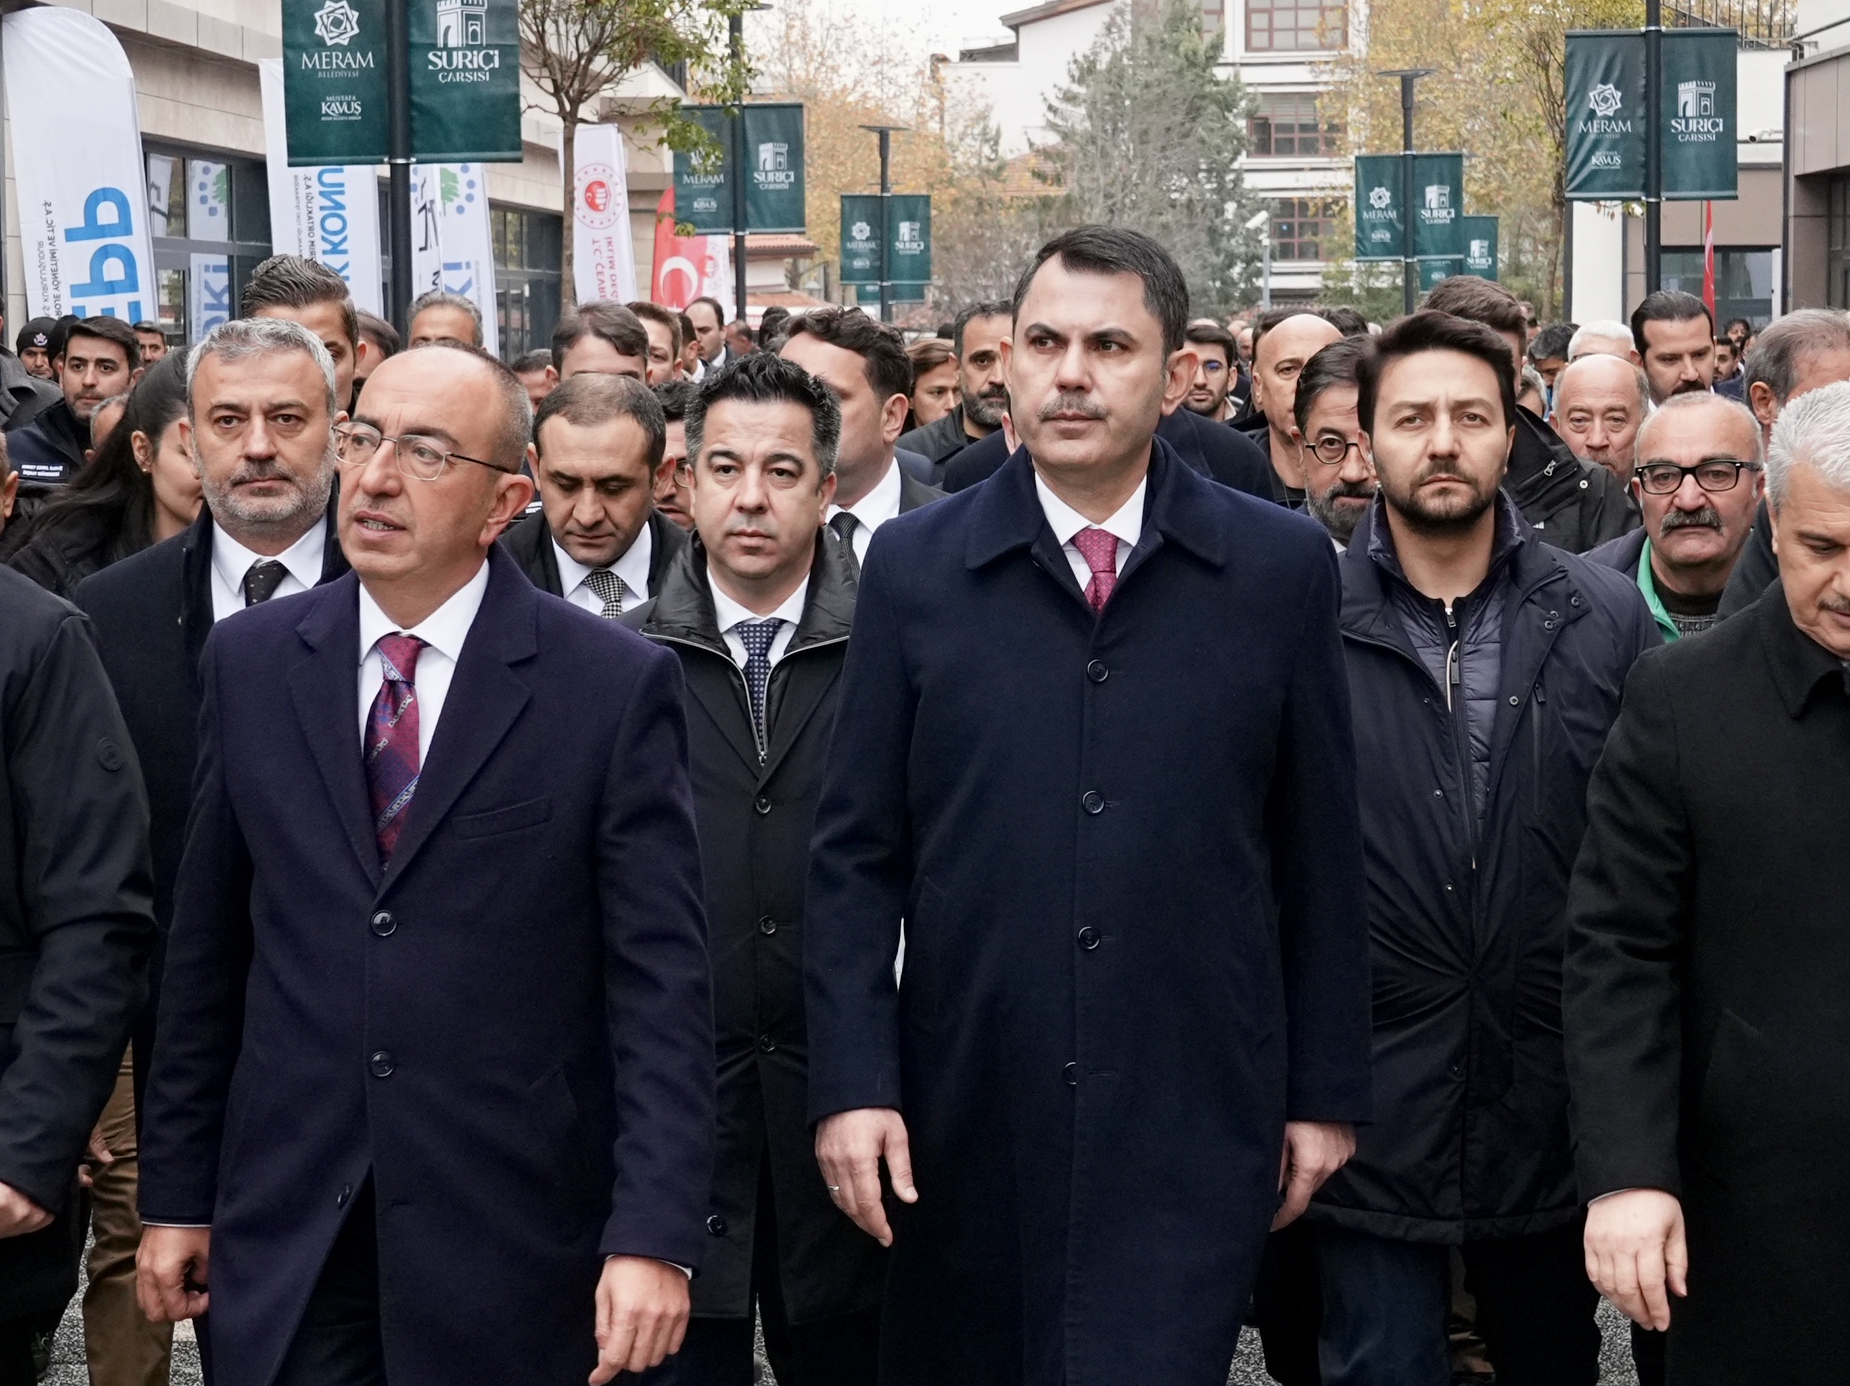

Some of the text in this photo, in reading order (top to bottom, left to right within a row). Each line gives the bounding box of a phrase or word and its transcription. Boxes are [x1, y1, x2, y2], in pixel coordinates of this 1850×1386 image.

[301, 51, 375, 69] MERAM
[428, 50, 499, 71] SURİÇİ
[321, 101, 362, 117] KAVUŞ
[1579, 119, 1632, 133] MERAM
[1670, 118, 1724, 133] SURİÇİ
[1363, 210, 1398, 220] MERAM
